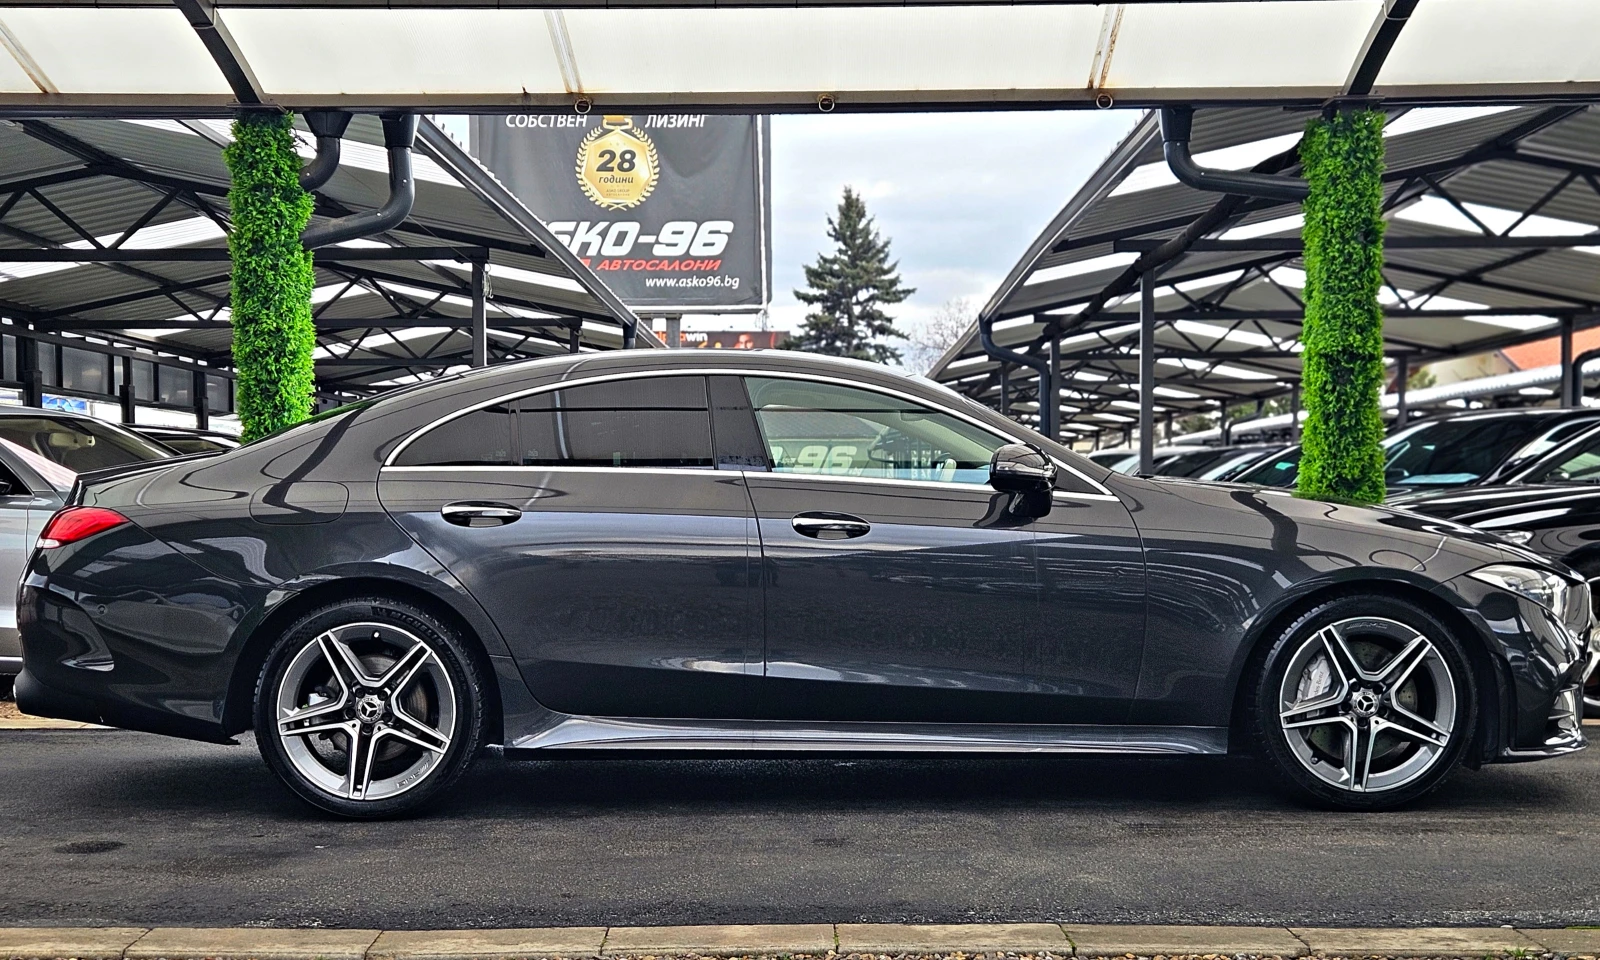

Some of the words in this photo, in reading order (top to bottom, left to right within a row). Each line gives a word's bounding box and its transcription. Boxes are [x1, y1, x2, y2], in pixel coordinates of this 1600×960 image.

[505, 115, 588, 128] СОБСТВЕН
[644, 115, 709, 129] ЛИЗИНГ
[596, 149, 636, 172] 28
[598, 174, 634, 184] години
[596, 259, 722, 271] АВТОСАЛОНИ
[645, 275, 740, 290] www.asko96.bg
